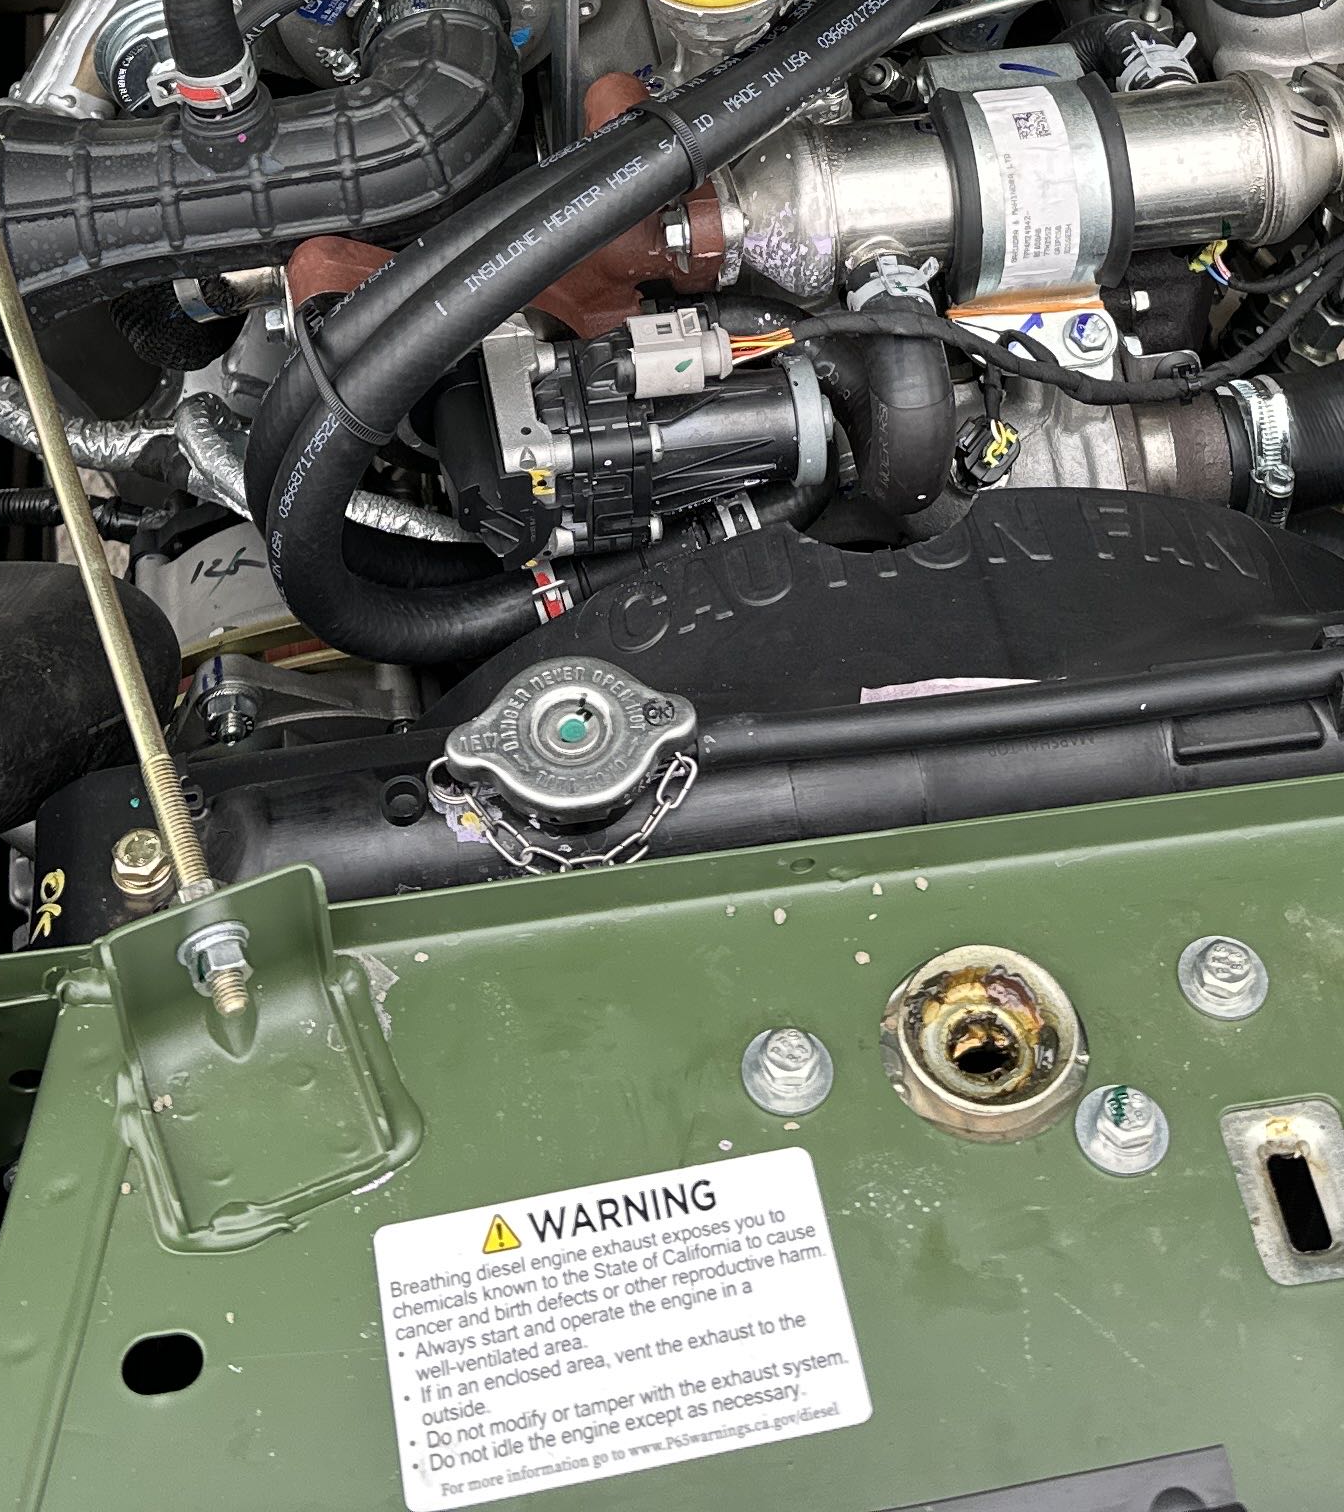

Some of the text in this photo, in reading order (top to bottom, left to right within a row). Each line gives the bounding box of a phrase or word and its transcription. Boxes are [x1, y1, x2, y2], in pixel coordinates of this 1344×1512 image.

[464, 228, 541, 293] INSULONE
[543, 185, 604, 233] HEATER
[606, 156, 649, 189] HOSE
[692, 115, 715, 133] ID
[723, 83, 762, 113] MADE
[762, 68, 785, 87] IN
[782, 50, 812, 73] USA
[1081, 494, 1257, 579] FAN
[390, 1210, 785, 1297] Breathing diesel engine exhaust exposes you to
[526, 1178, 716, 1243] WARNING
[392, 1225, 815, 1319] chemicals known to the State of California to cause
[395, 1245, 826, 1340] cancer and birth defects or other reproductive harm.
[415, 1281, 752, 1359] Always start and operate the engine in a
[415, 1337, 587, 1381] well-ventilated area.
[421, 1314, 805, 1403] If in an enclosed area, vent the exhaust to the
[422, 1399, 489, 1426] outside.
[426, 1352, 847, 1448] Do not modify or tamper with the exhaust system.
[429, 1384, 803, 1471] Do not idle the engine except as necessary.
